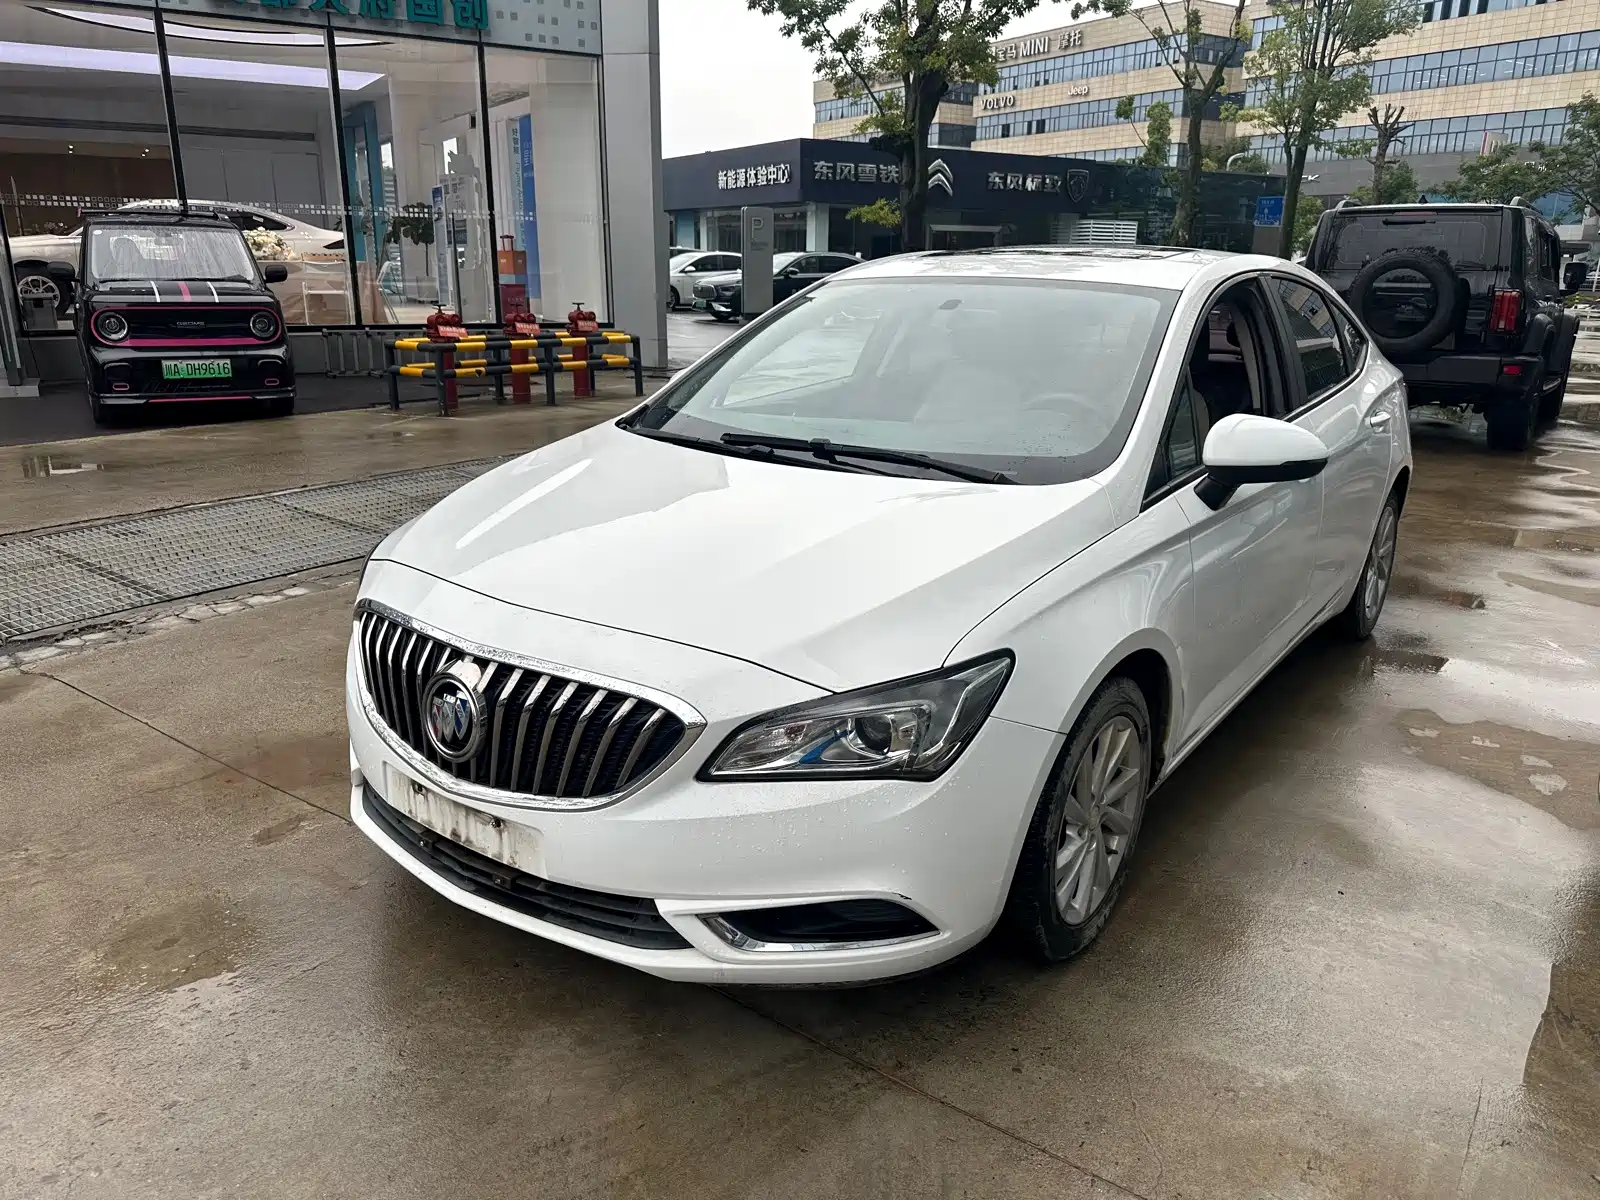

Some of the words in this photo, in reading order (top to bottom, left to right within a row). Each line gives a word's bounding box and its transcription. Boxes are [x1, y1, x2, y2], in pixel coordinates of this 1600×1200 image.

[1020, 36, 1049, 57] MINI
[1058, 29, 1081, 49] 摩托
[1068, 85, 1088, 96] Jeep
[980, 95, 1014, 110] VOLVO
[718, 163, 790, 190] 新能源体验中心
[813, 160, 906, 184] 东风雪铁
[987, 172, 1062, 192] 东风标致
